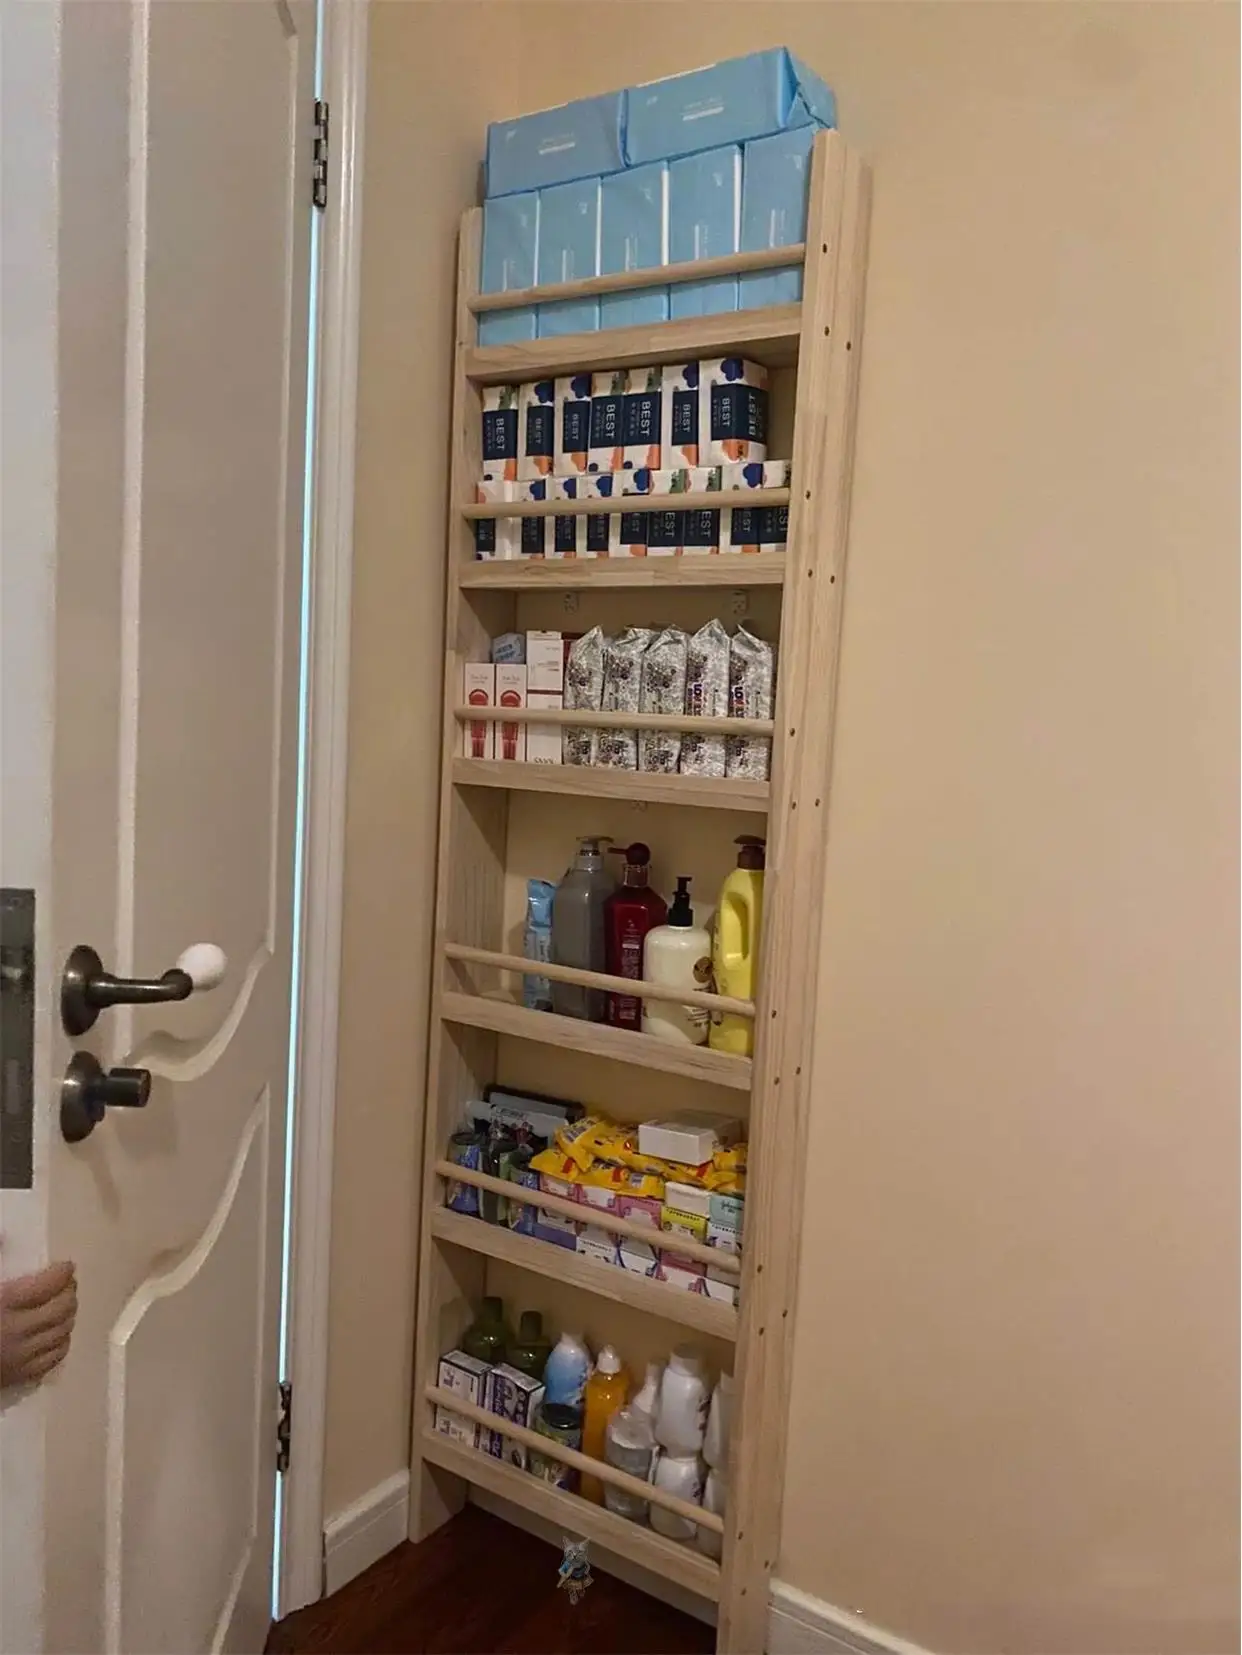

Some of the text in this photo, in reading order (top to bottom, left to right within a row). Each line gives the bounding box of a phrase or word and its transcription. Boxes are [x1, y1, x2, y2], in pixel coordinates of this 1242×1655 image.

[605, 403, 616, 438] BEST
[640, 401, 651, 436] BEST
[682, 404, 691, 433] BEST
[721, 398, 731, 427] BEST
[496, 418, 505, 450] BEST
[665, 511, 675, 538] EST
[701, 510, 712, 538] EST
[743, 509, 751, 533] EST
